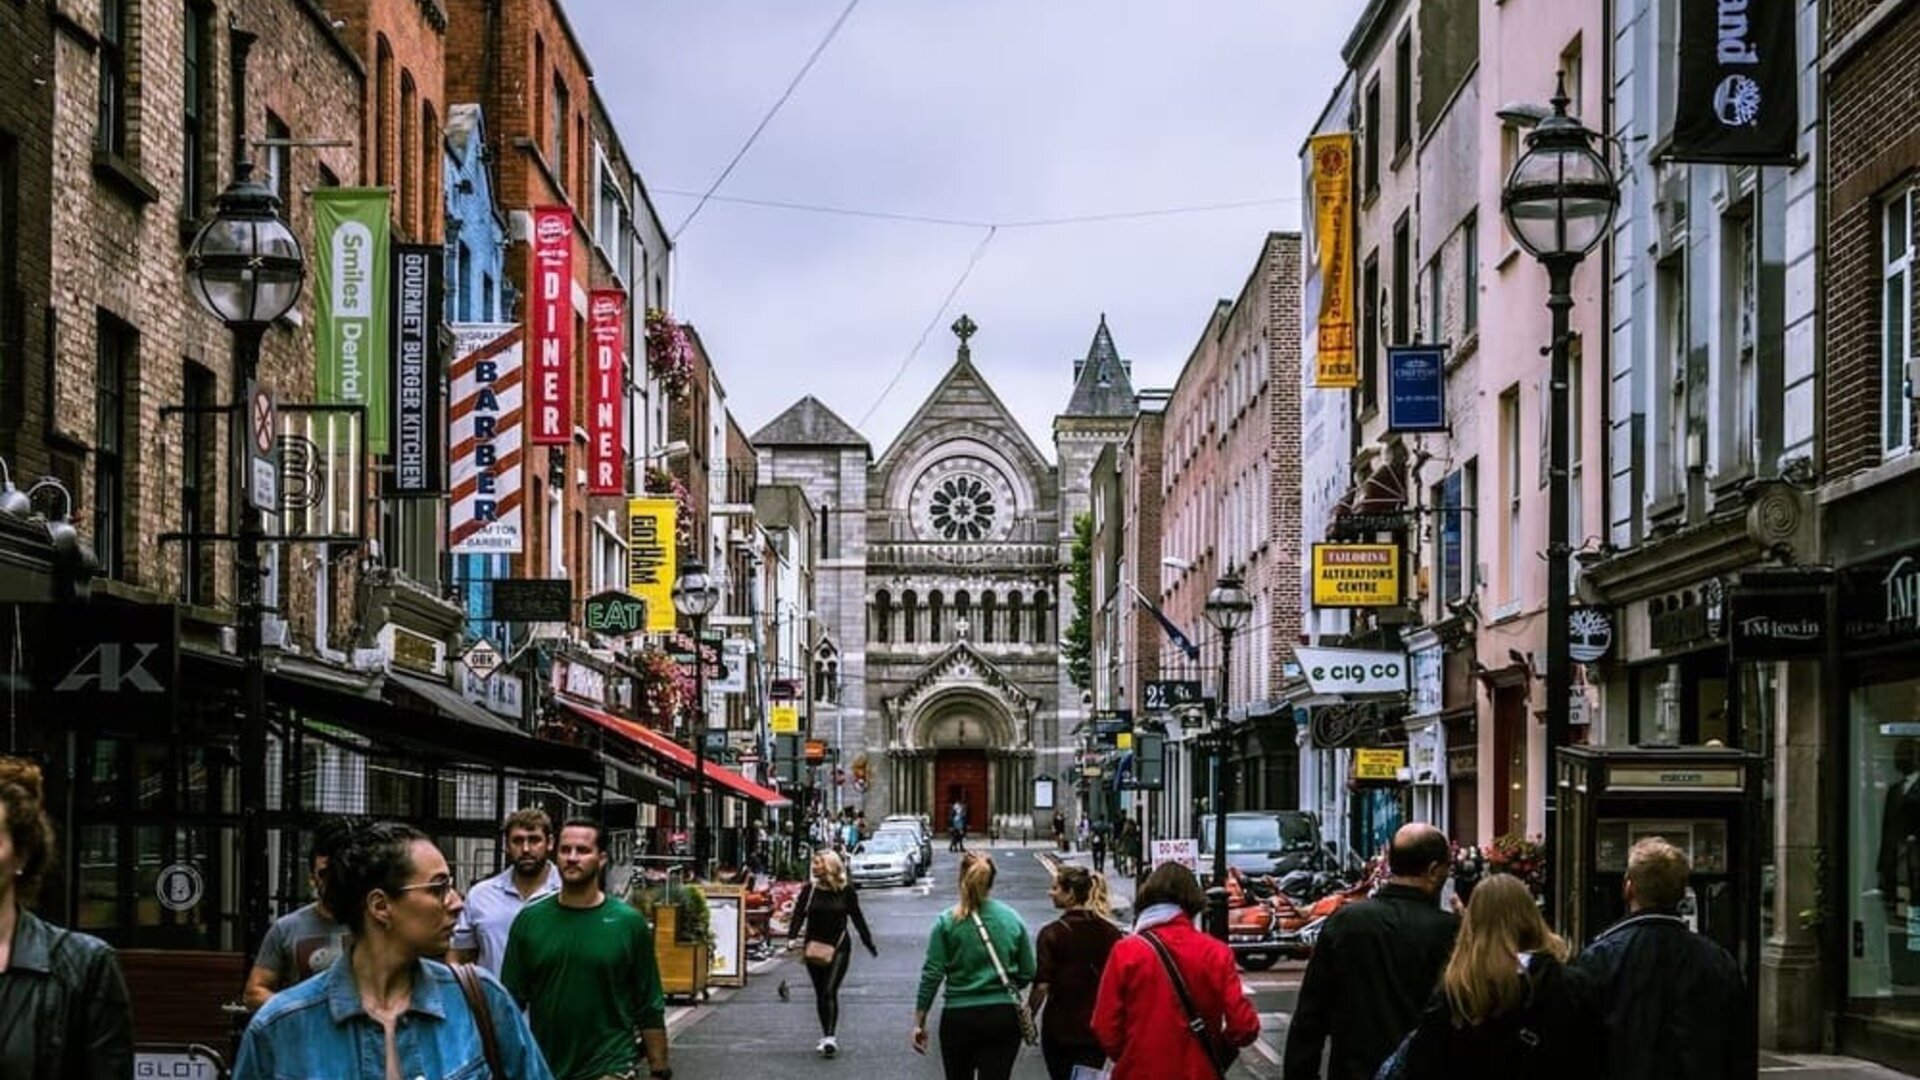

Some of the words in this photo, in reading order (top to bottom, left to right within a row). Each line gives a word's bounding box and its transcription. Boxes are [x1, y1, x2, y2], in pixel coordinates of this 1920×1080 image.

[343, 234, 365, 309] Smiles
[403, 254, 423, 337] GOURMET
[341, 322, 363, 400] Dental
[403, 341, 421, 408] BURGER
[542, 271, 560, 436] DINER
[402, 413, 421, 489] KITCHEN
[474, 360, 500, 522] BARBER
[597, 345, 614, 487] DINER
[1322, 568, 1394, 580] ALTERATIONS
[1327, 551, 1388, 563] TAILORING
[1336, 581, 1378, 594] CENTRE
[588, 601, 643, 630] EAT
[1311, 666, 1326, 681] e
[1330, 664, 1366, 684] cig
[1370, 663, 1399, 679] co
